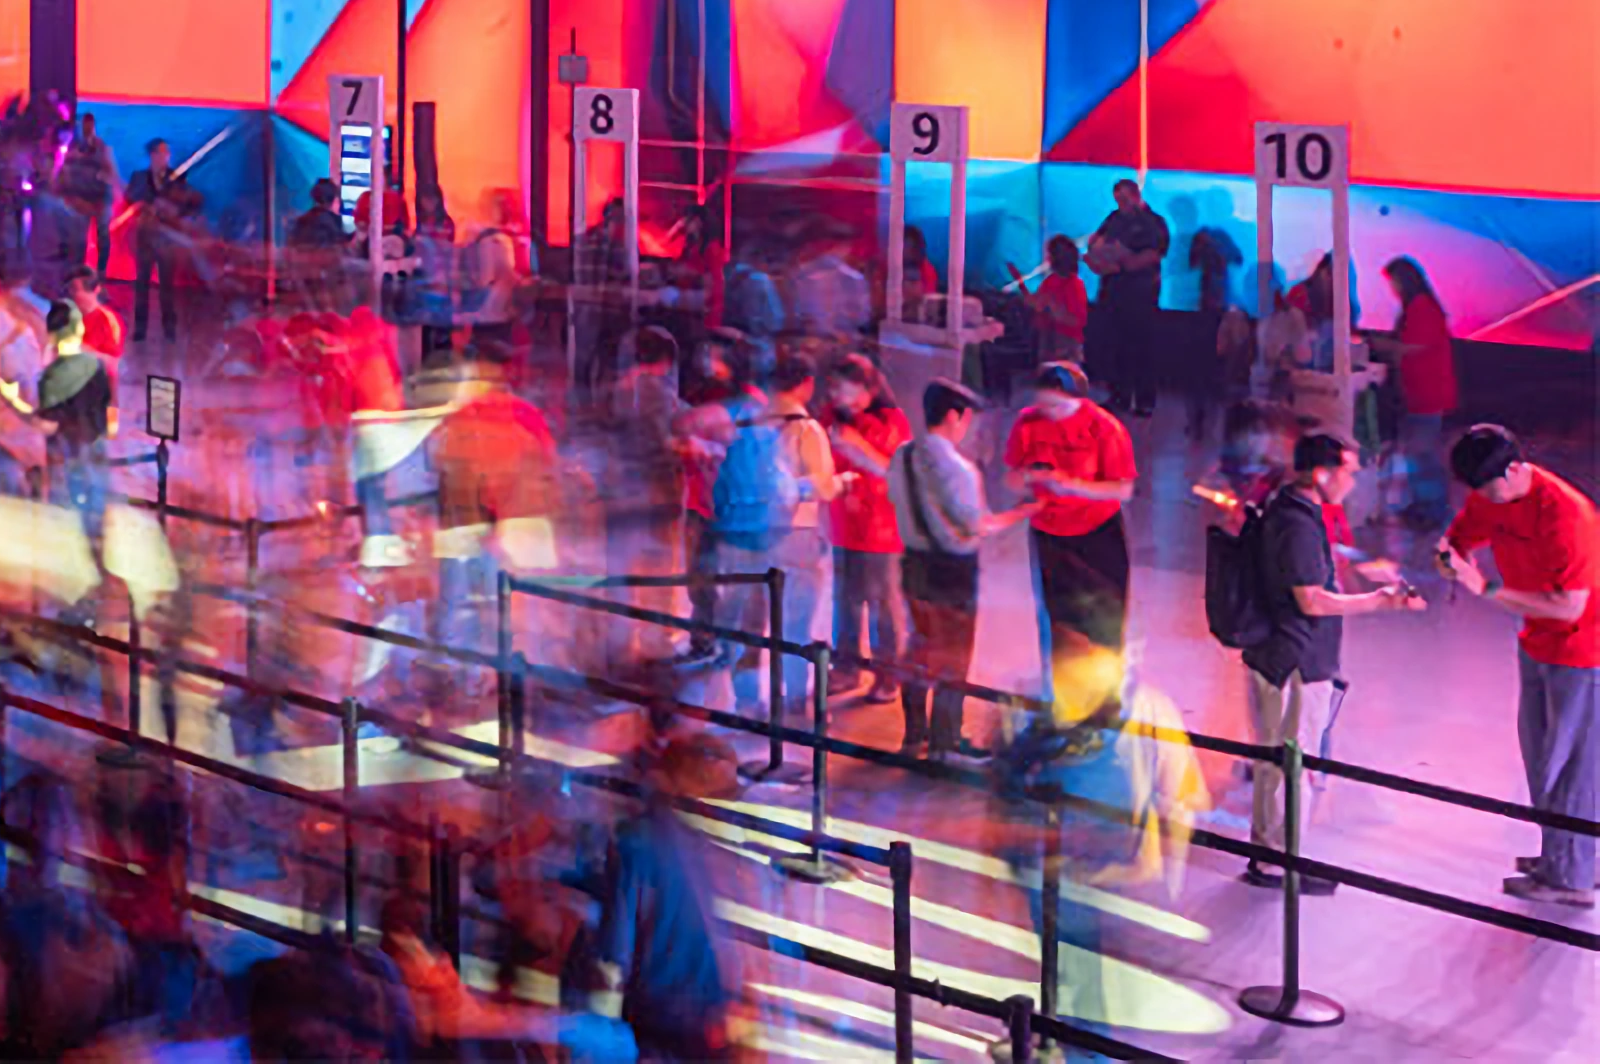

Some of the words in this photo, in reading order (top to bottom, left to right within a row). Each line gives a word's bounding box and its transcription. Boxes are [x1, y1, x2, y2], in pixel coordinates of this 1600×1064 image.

[341, 80, 363, 116] 7
[589, 93, 614, 135] 8
[912, 112, 940, 155] 9
[1263, 132, 1333, 182] 10
